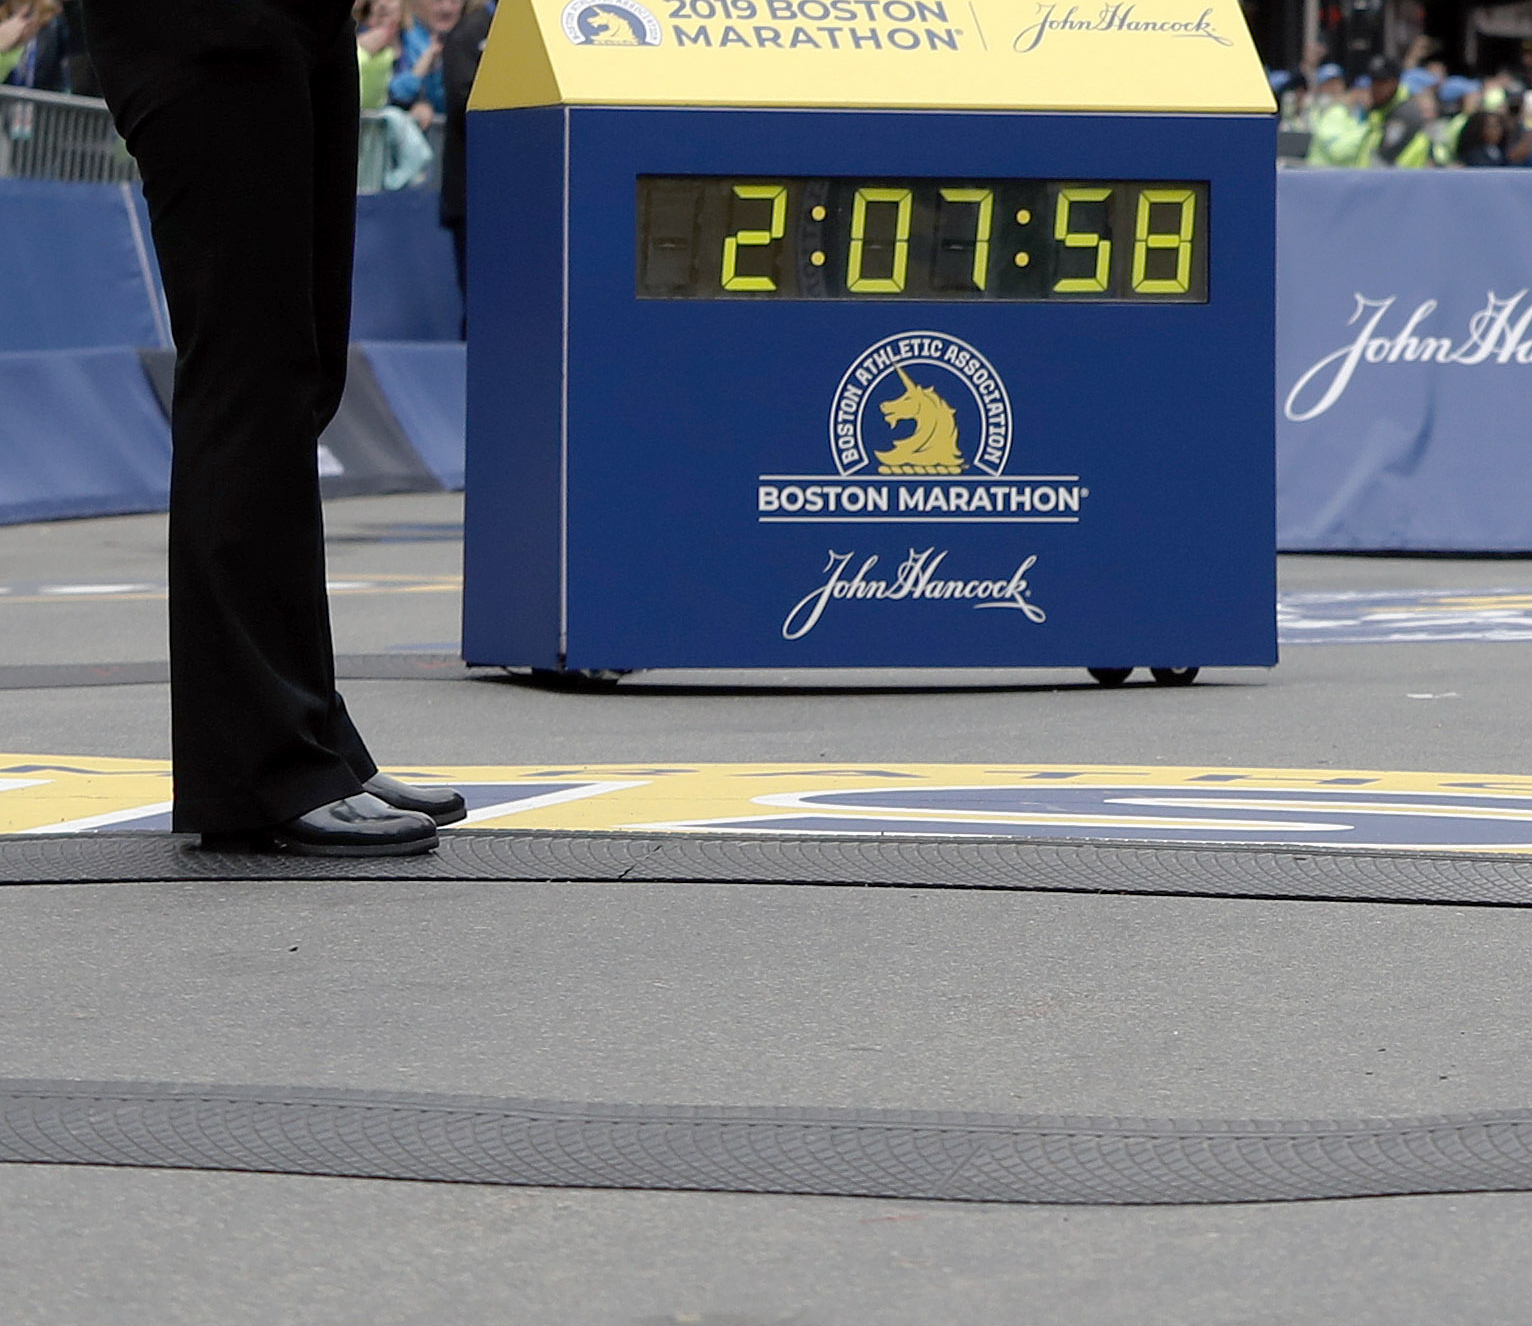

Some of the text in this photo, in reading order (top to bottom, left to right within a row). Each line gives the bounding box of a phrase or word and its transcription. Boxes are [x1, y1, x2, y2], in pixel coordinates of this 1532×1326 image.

[673, 25, 959, 52] MARATHON
[721, 185, 1196, 293] 2:07:58
[837, 338, 1006, 465] BOSTON ATHLETIC ASSOCIATION
[758, 486, 1080, 512] BOSTON MARATHON
